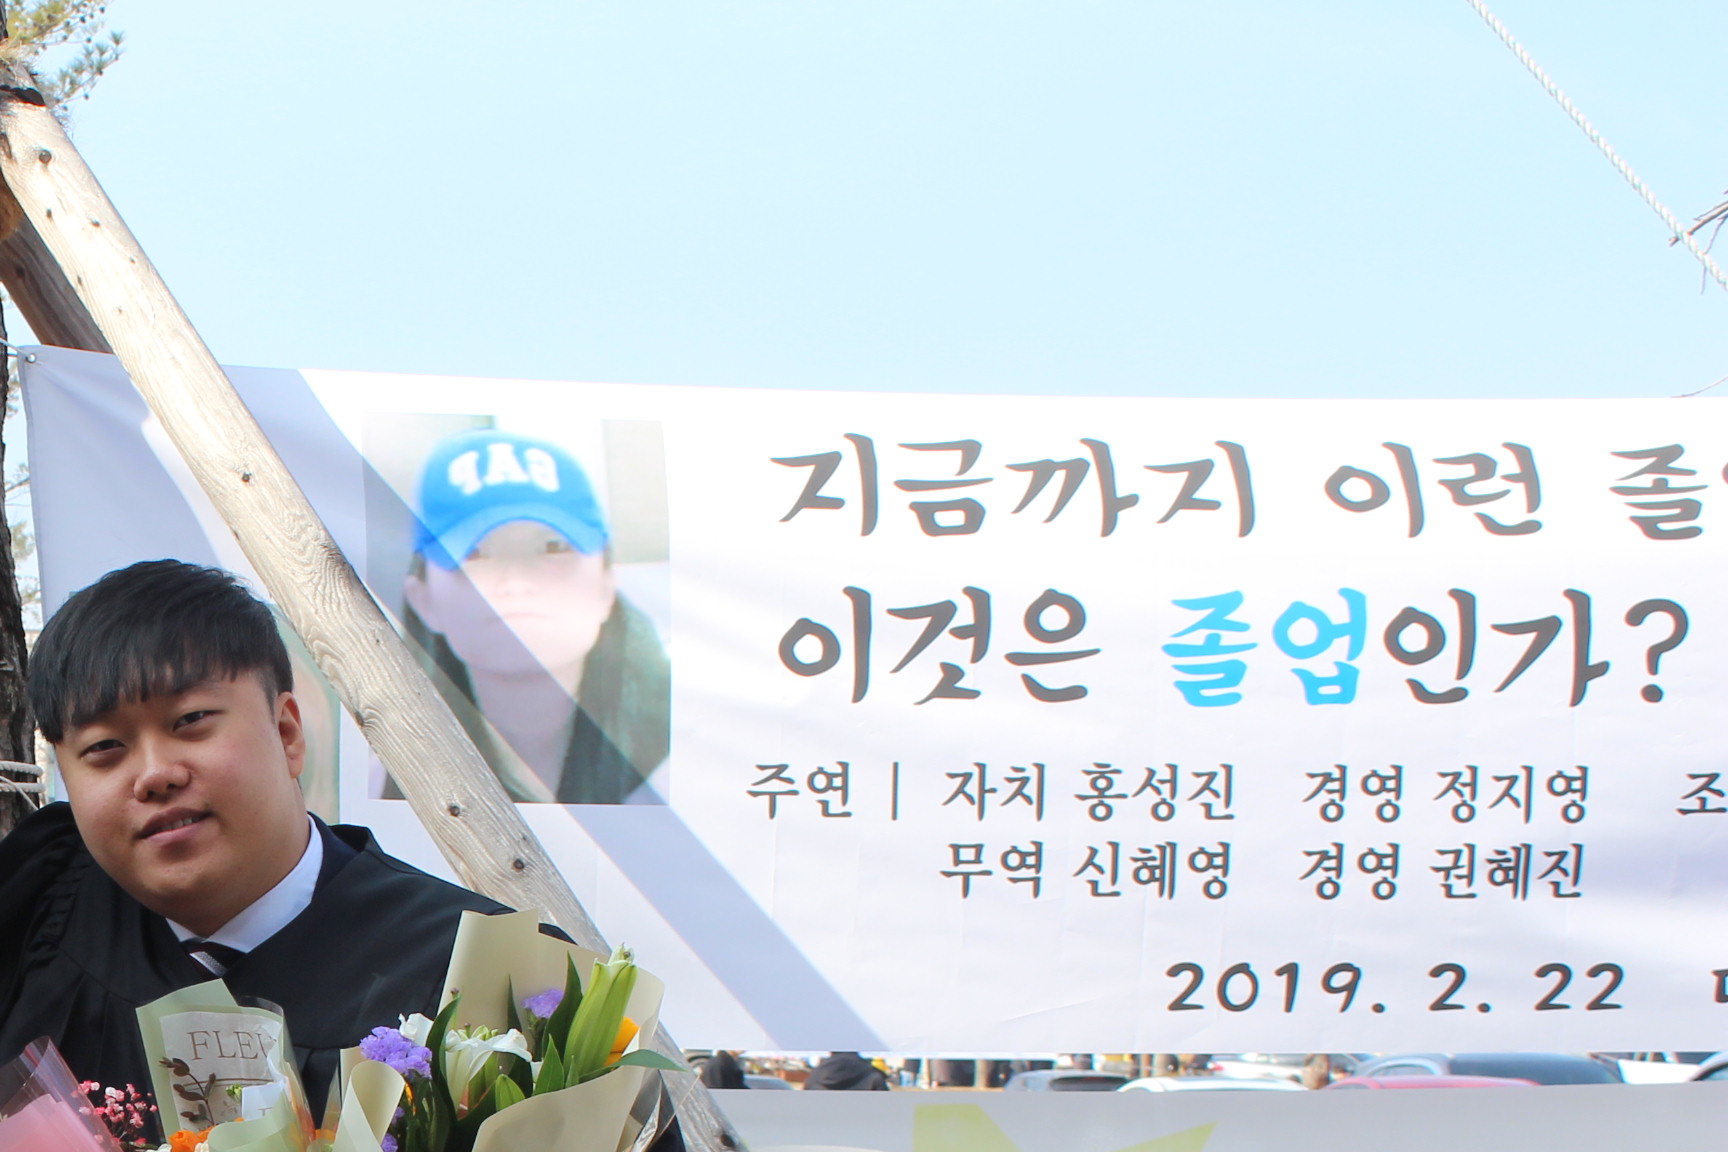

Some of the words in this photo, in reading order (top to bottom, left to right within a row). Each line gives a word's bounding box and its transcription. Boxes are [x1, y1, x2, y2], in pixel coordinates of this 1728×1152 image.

[770, 432, 1258, 538] 지금까지
[1324, 441, 1544, 539] 이런
[1608, 442, 1728, 541] 졸
[777, 585, 1103, 706] 이것은
[1161, 587, 1692, 708] 졸업인가?
[746, 760, 853, 820] 주연
[941, 761, 1047, 822] 자치
[1073, 762, 1236, 822] 홍성진
[1302, 763, 1405, 824] 경영
[1433, 764, 1591, 824] 정지영
[939, 840, 1045, 899] 무역
[1072, 841, 1232, 900] 신혜영
[1299, 842, 1402, 901] 경영
[1430, 842, 1585, 900] 권혜진
[1165, 961, 1388, 1014] 2019.
[1427, 961, 1493, 1013] 2.
[1534, 961, 1626, 1011] 22
